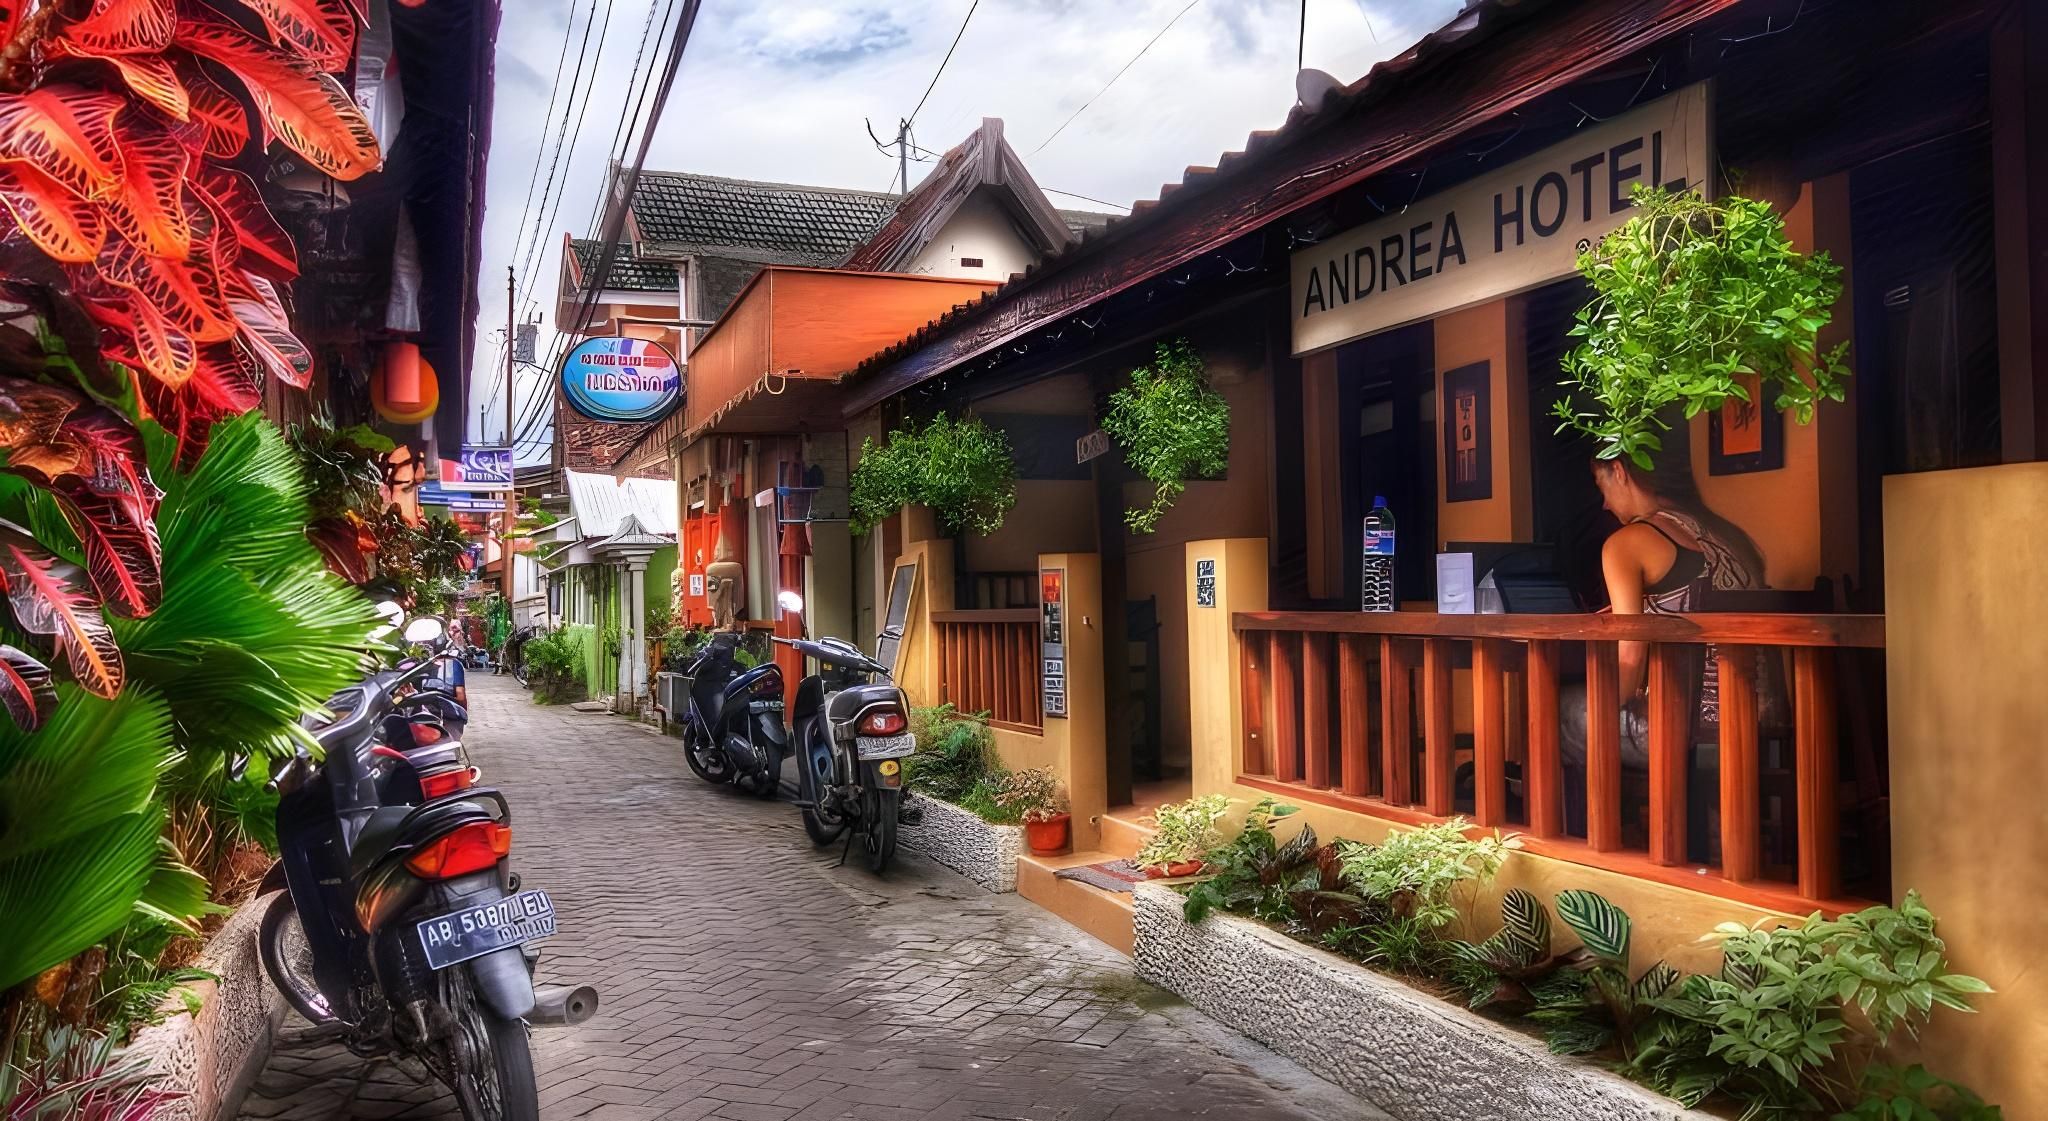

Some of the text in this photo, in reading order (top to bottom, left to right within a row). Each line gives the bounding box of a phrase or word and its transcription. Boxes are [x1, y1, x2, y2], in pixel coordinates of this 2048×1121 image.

[1303, 130, 1687, 318] ANDREA HOTEL
[427, 920, 453, 948] AB
